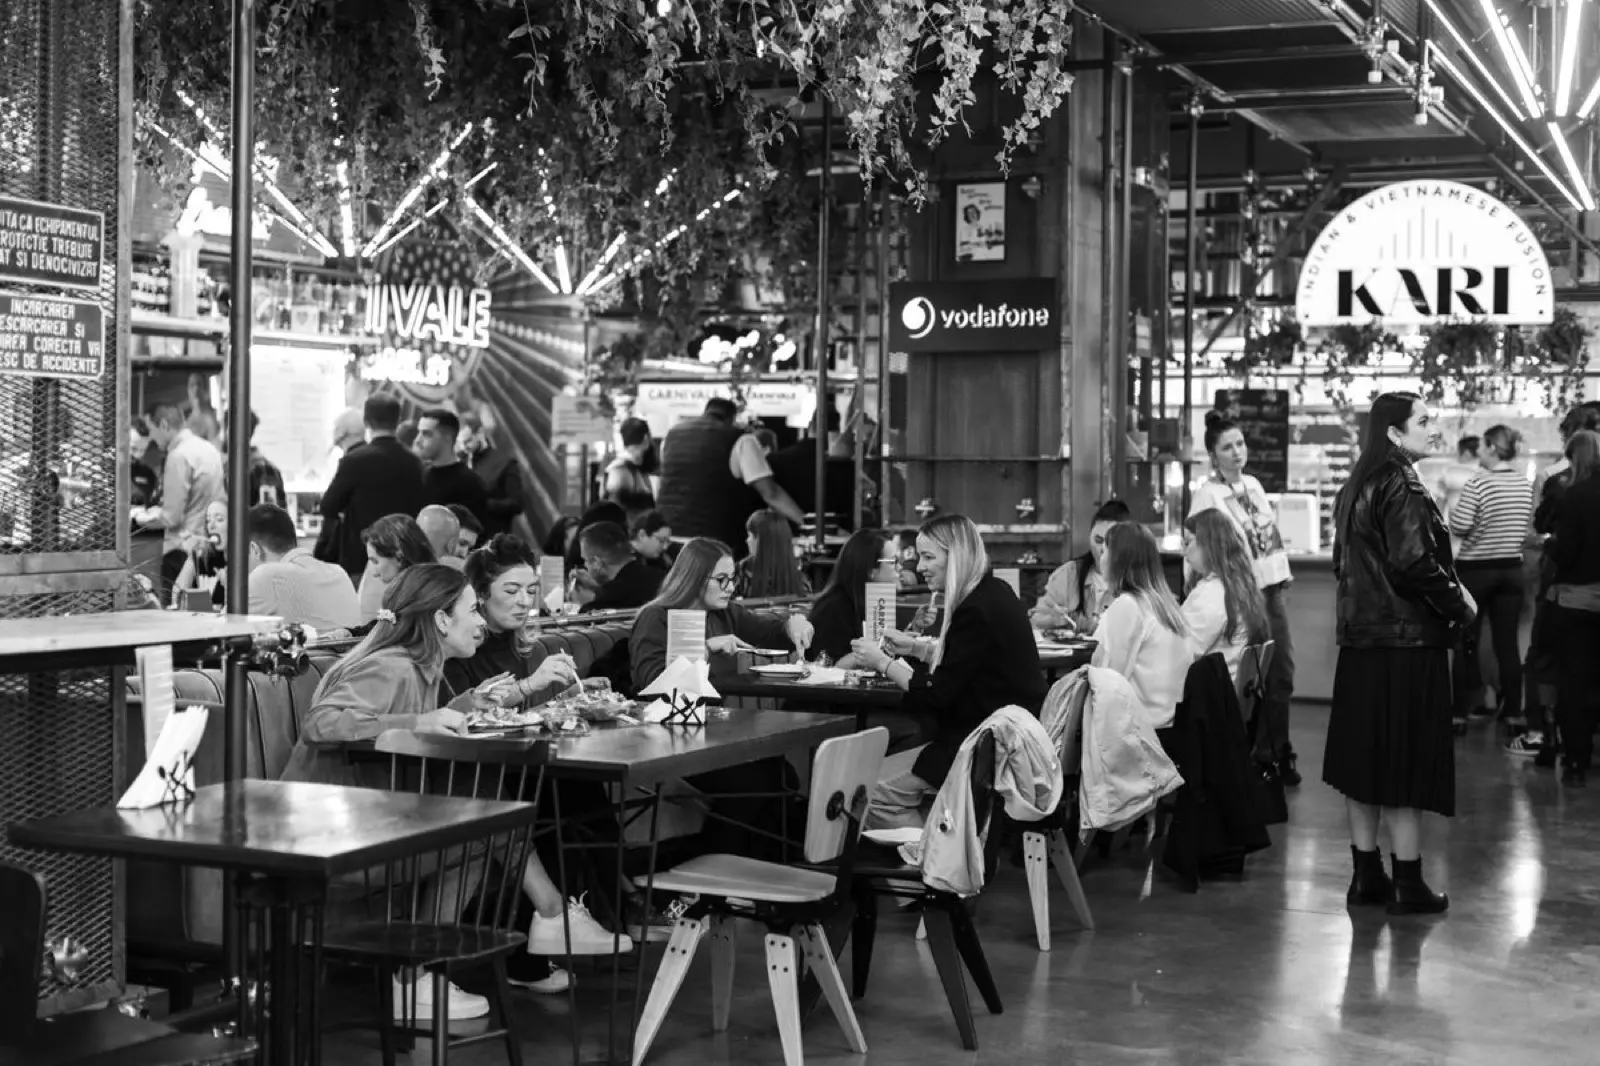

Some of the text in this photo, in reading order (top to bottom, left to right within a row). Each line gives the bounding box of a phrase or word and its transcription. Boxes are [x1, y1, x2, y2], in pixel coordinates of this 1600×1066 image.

[1303, 185, 1548, 298] INDIAN & VIETNAMESE FUSION
[1337, 265, 1510, 318] KARI
[940, 302, 1050, 329] vodafone
[33, 336, 82, 355] CORECTA
[23, 351, 38, 369] DE
[42, 354, 98, 374] ACCIDENTE
